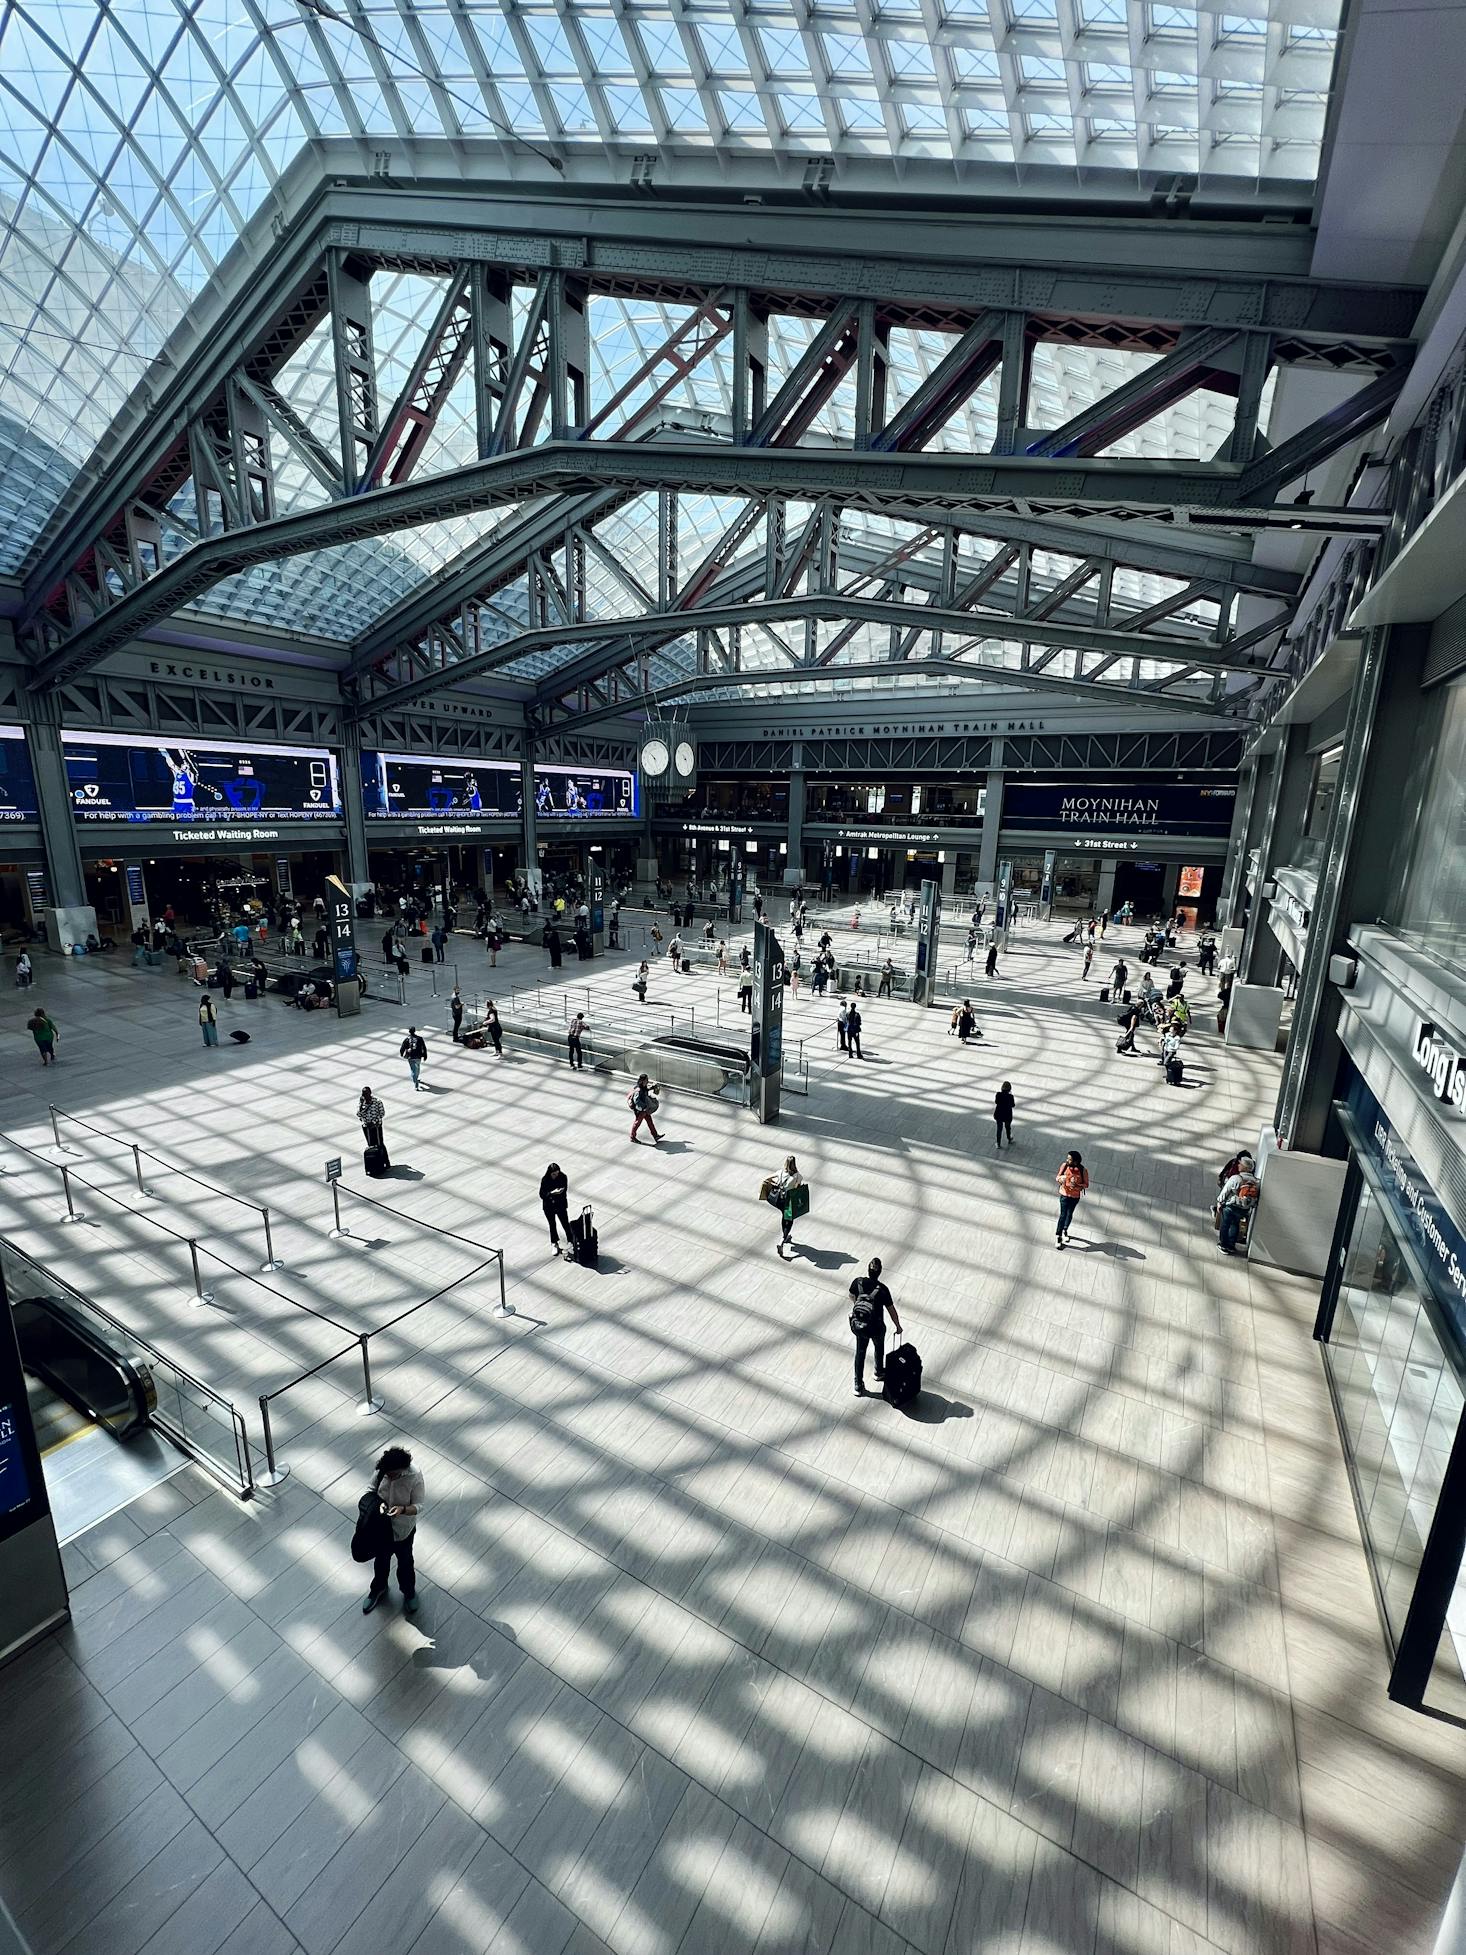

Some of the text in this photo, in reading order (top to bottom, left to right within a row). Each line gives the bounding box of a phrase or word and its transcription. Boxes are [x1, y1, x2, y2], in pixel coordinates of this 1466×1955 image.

[150, 662, 274, 689] EXCELSIOR
[443, 704, 493, 718] UPWARD
[763, 721, 1045, 737] DANIEL PATRICK MOYNIHAN TRAIN HALL
[76, 798, 111, 806] FANDUEL
[1061, 798, 1159, 811] MOYNIHAN
[84, 811, 98, 820] For
[100, 811, 116, 821] help
[118, 812, 134, 820] with
[142, 812, 175, 821] gambling
[176, 812, 204, 821] problem
[1059, 811, 1160, 825] TRAIN HALL
[173, 829, 278, 840] Ticketed Waiting Room
[418, 825, 482, 834] Ticketed Waiting Room
[730, 825, 746, 833] Street
[846, 830, 930, 841] Amtrak Metropolitan Lounge
[1084, 840, 1128, 849] 31st Street
[594, 877, 602, 887] 11
[594, 891, 603, 902] 12
[335, 903, 349, 917] 13
[922, 904, 929, 917] 11
[337, 924, 351, 938] 14
[920, 922, 929, 935] 12
[772, 962, 783, 981] 13
[771, 991, 782, 1011] 14
[1412, 1021, 1450, 1098] Long
[1405, 1178, 1420, 1208] and
[1416, 1196, 1450, 1263] Customer
